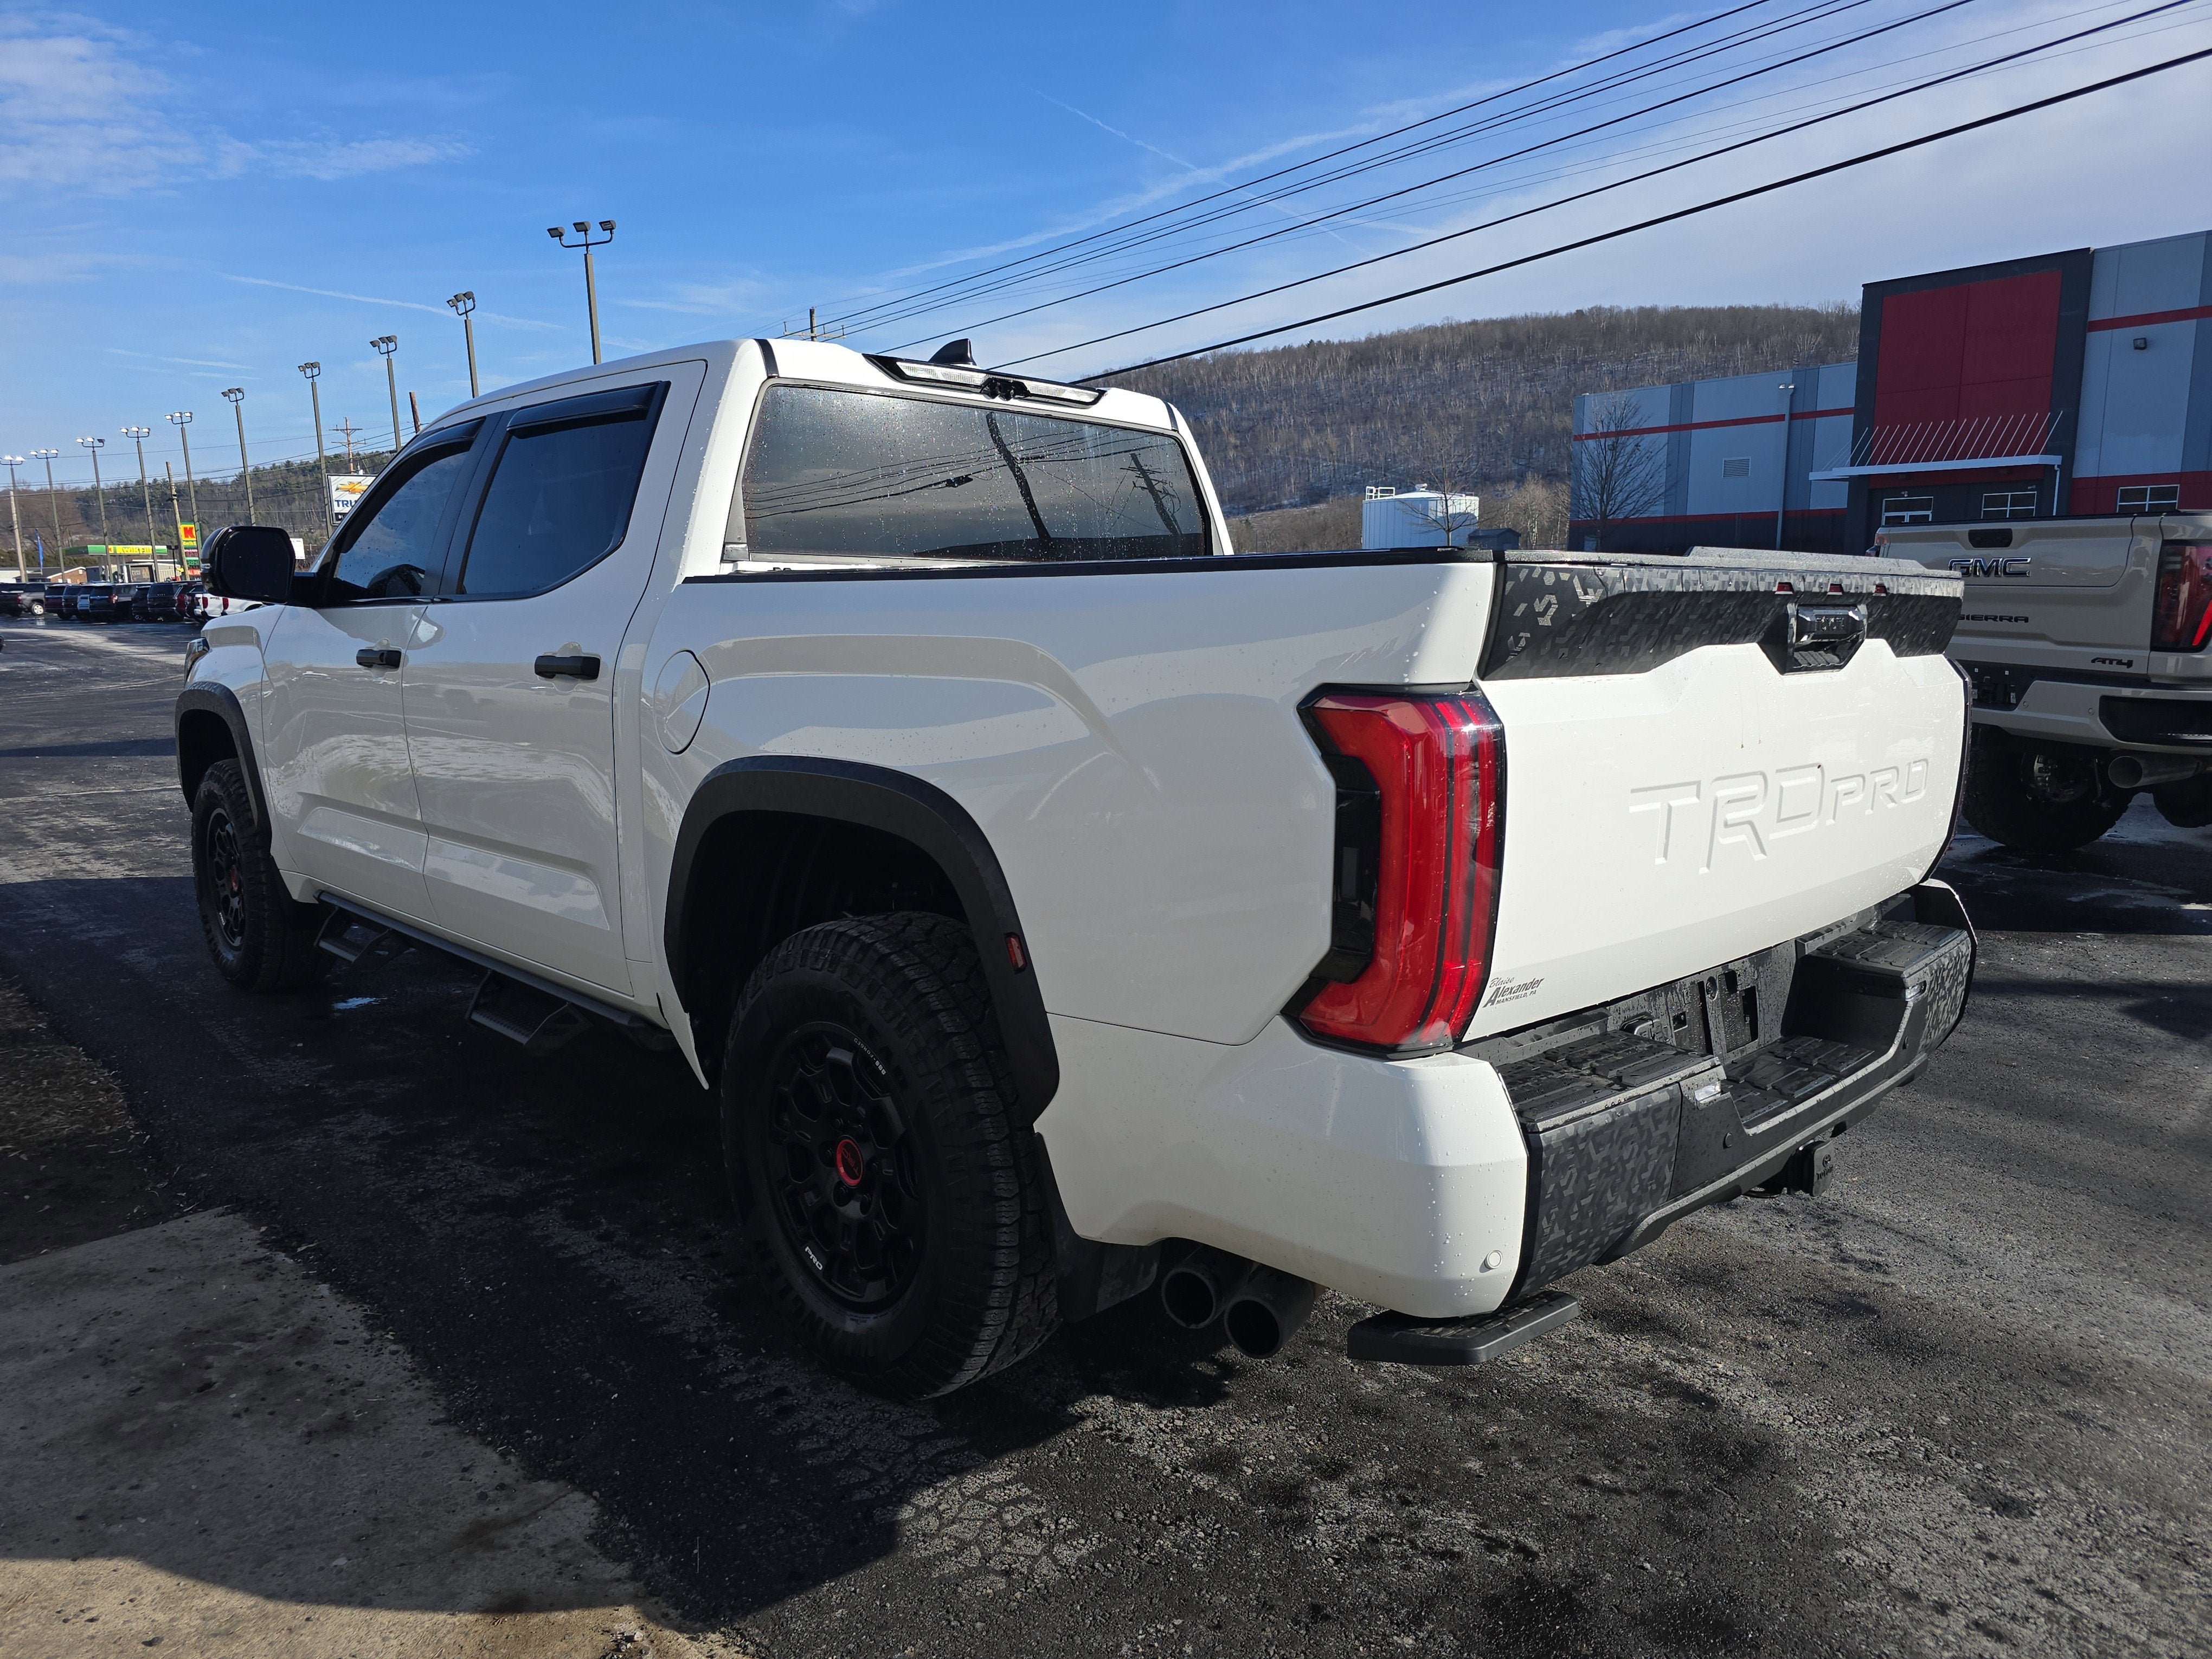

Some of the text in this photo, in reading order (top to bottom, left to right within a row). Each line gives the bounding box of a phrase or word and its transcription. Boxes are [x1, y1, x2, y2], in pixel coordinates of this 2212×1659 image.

[184, 527, 195, 538] K
[1948, 557, 2031, 577] GMC
[1958, 614, 2029, 623] SIERRA
[2091, 657, 2134, 669] AT4
[1629, 758, 1929, 874] TRD PRO
[1483, 978, 1544, 1008] Alexander
[1496, 993, 1527, 1005] MANSFIELD,
[805, 1246, 823, 1270] PRO
